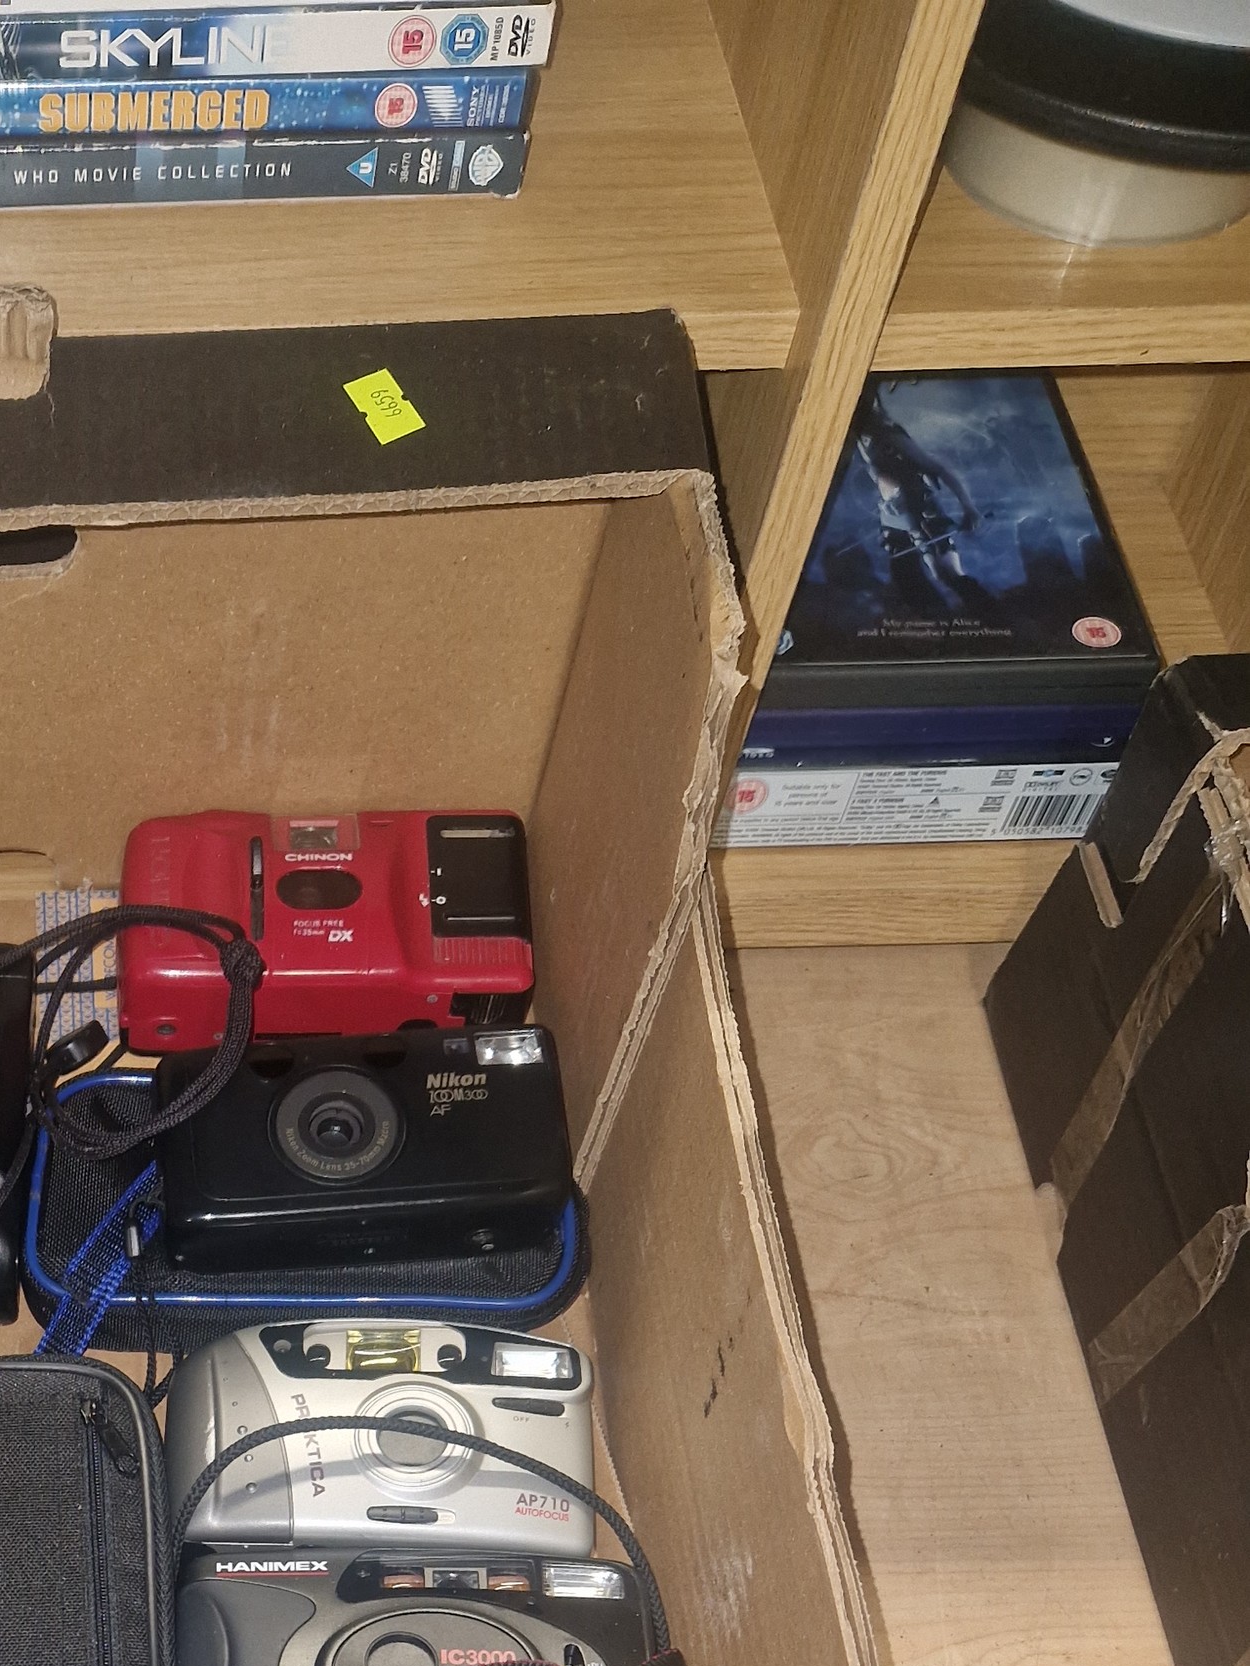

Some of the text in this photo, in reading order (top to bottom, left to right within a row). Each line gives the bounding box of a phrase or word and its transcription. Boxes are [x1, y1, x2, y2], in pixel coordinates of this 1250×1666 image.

[402, 29, 424, 55] 15
[453, 28, 476, 52] 15
[508, 14, 523, 57] DVD
[526, 18, 536, 56] VIDEO
[59, 24, 291, 69] SKYLINE
[38, 88, 270, 133] SUBMERGED
[388, 97, 404, 116] 15
[467, 86, 480, 127] SONY
[14, 169, 59, 186] WHO
[74, 166, 142, 183] MOVIE
[157, 162, 292, 181] COLLECTION
[359, 162, 372, 174] U
[418, 148, 432, 184] DVD
[1050, 826, 1085, 835] 10798
[285, 853, 353, 862] CHINON
[322, 919, 344, 928] FREE
[328, 928, 354, 942] DX
[426, 1071, 486, 1089] Nikon
[429, 1104, 452, 1117] AF
[321, 1161, 343, 1172] Lens
[290, 1393, 326, 1498] PRKTICA
[516, 1492, 571, 1513] AP710
[515, 1506, 570, 1522] AUTOFOCUS
[215, 1560, 329, 1574] HANIMEX
[440, 1649, 517, 1666] IC3000
